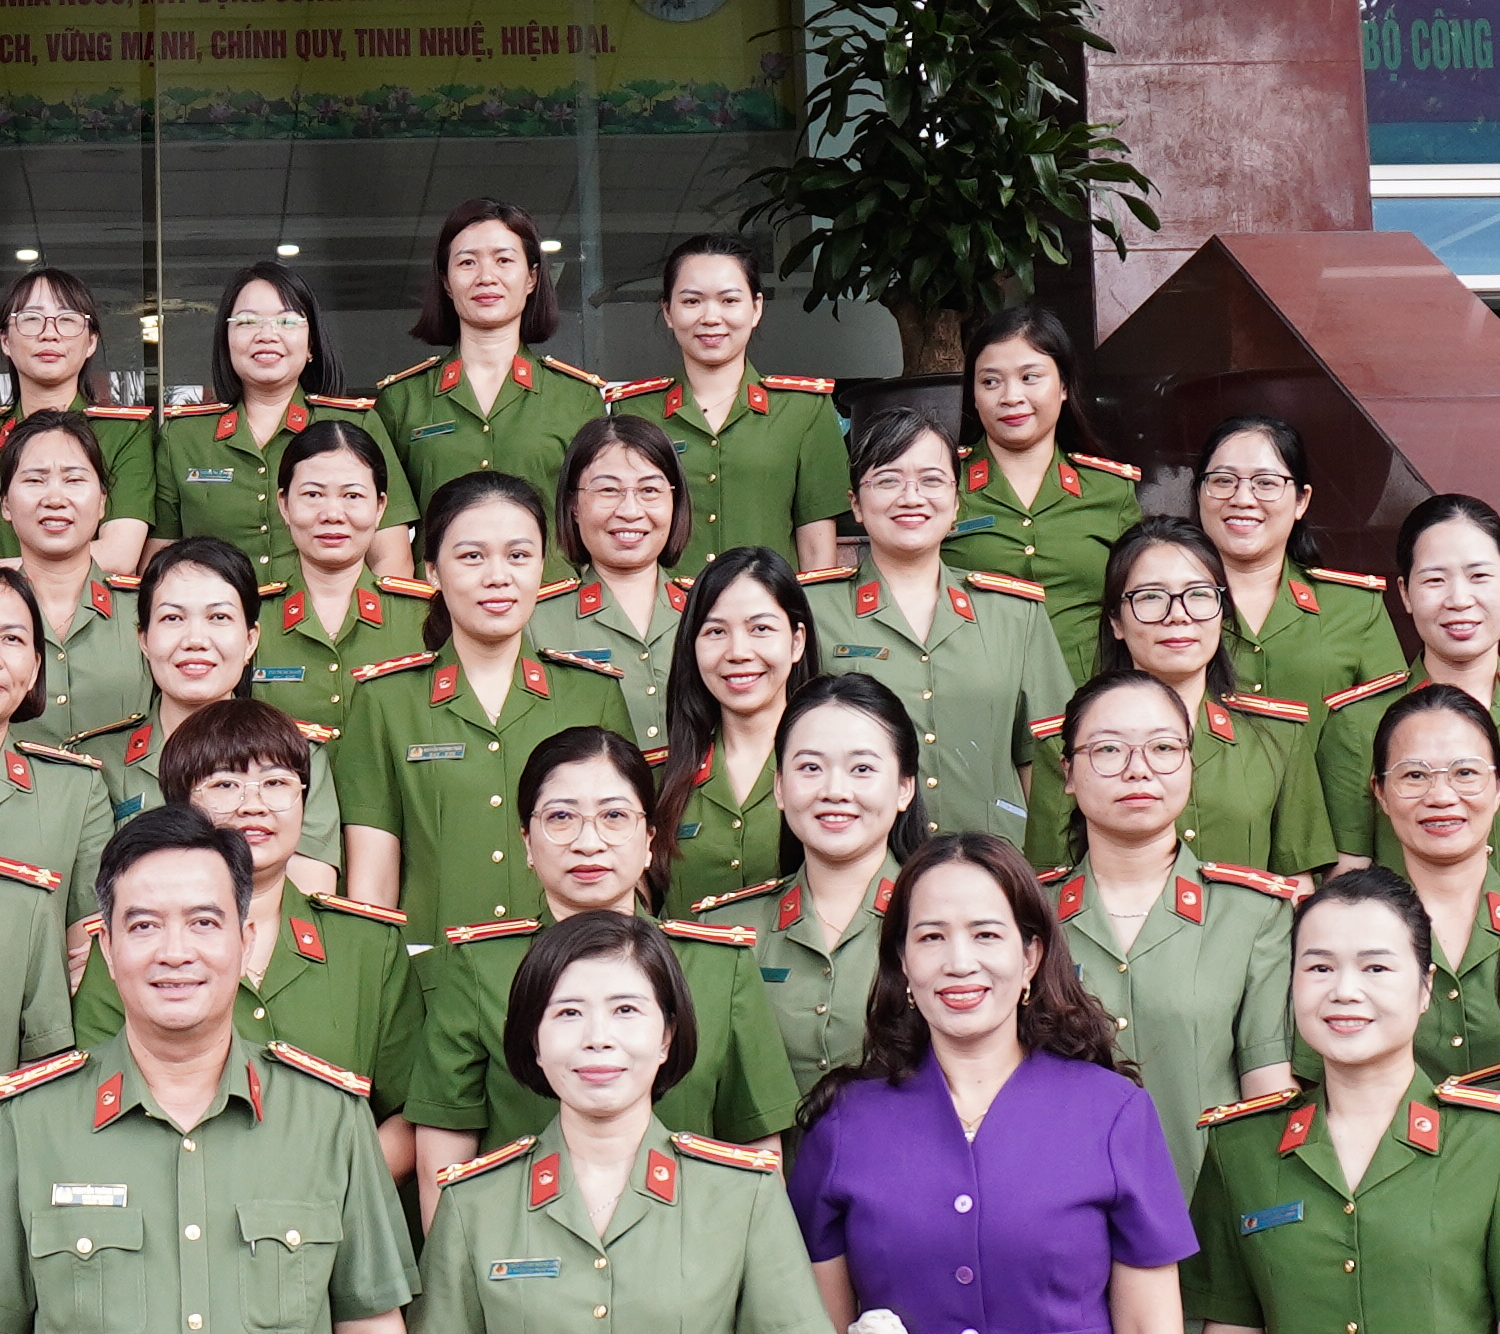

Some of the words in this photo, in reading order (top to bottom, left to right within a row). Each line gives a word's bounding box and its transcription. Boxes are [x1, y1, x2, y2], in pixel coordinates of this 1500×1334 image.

[45, 27, 112, 63] VỮNG
[121, 30, 203, 67] MẠNH,
[211, 25, 288, 60] CHÍNH
[295, 29, 347, 62] QUY,
[354, 27, 411, 57] TINH
[419, 20, 493, 62] NHUỆ,
[501, 20, 560, 62] HIỆN
[566, 24, 617, 60] ĐẠI.
[1363, 5, 1402, 81] BỘ
[1411, 8, 1494, 69] CÔNG
